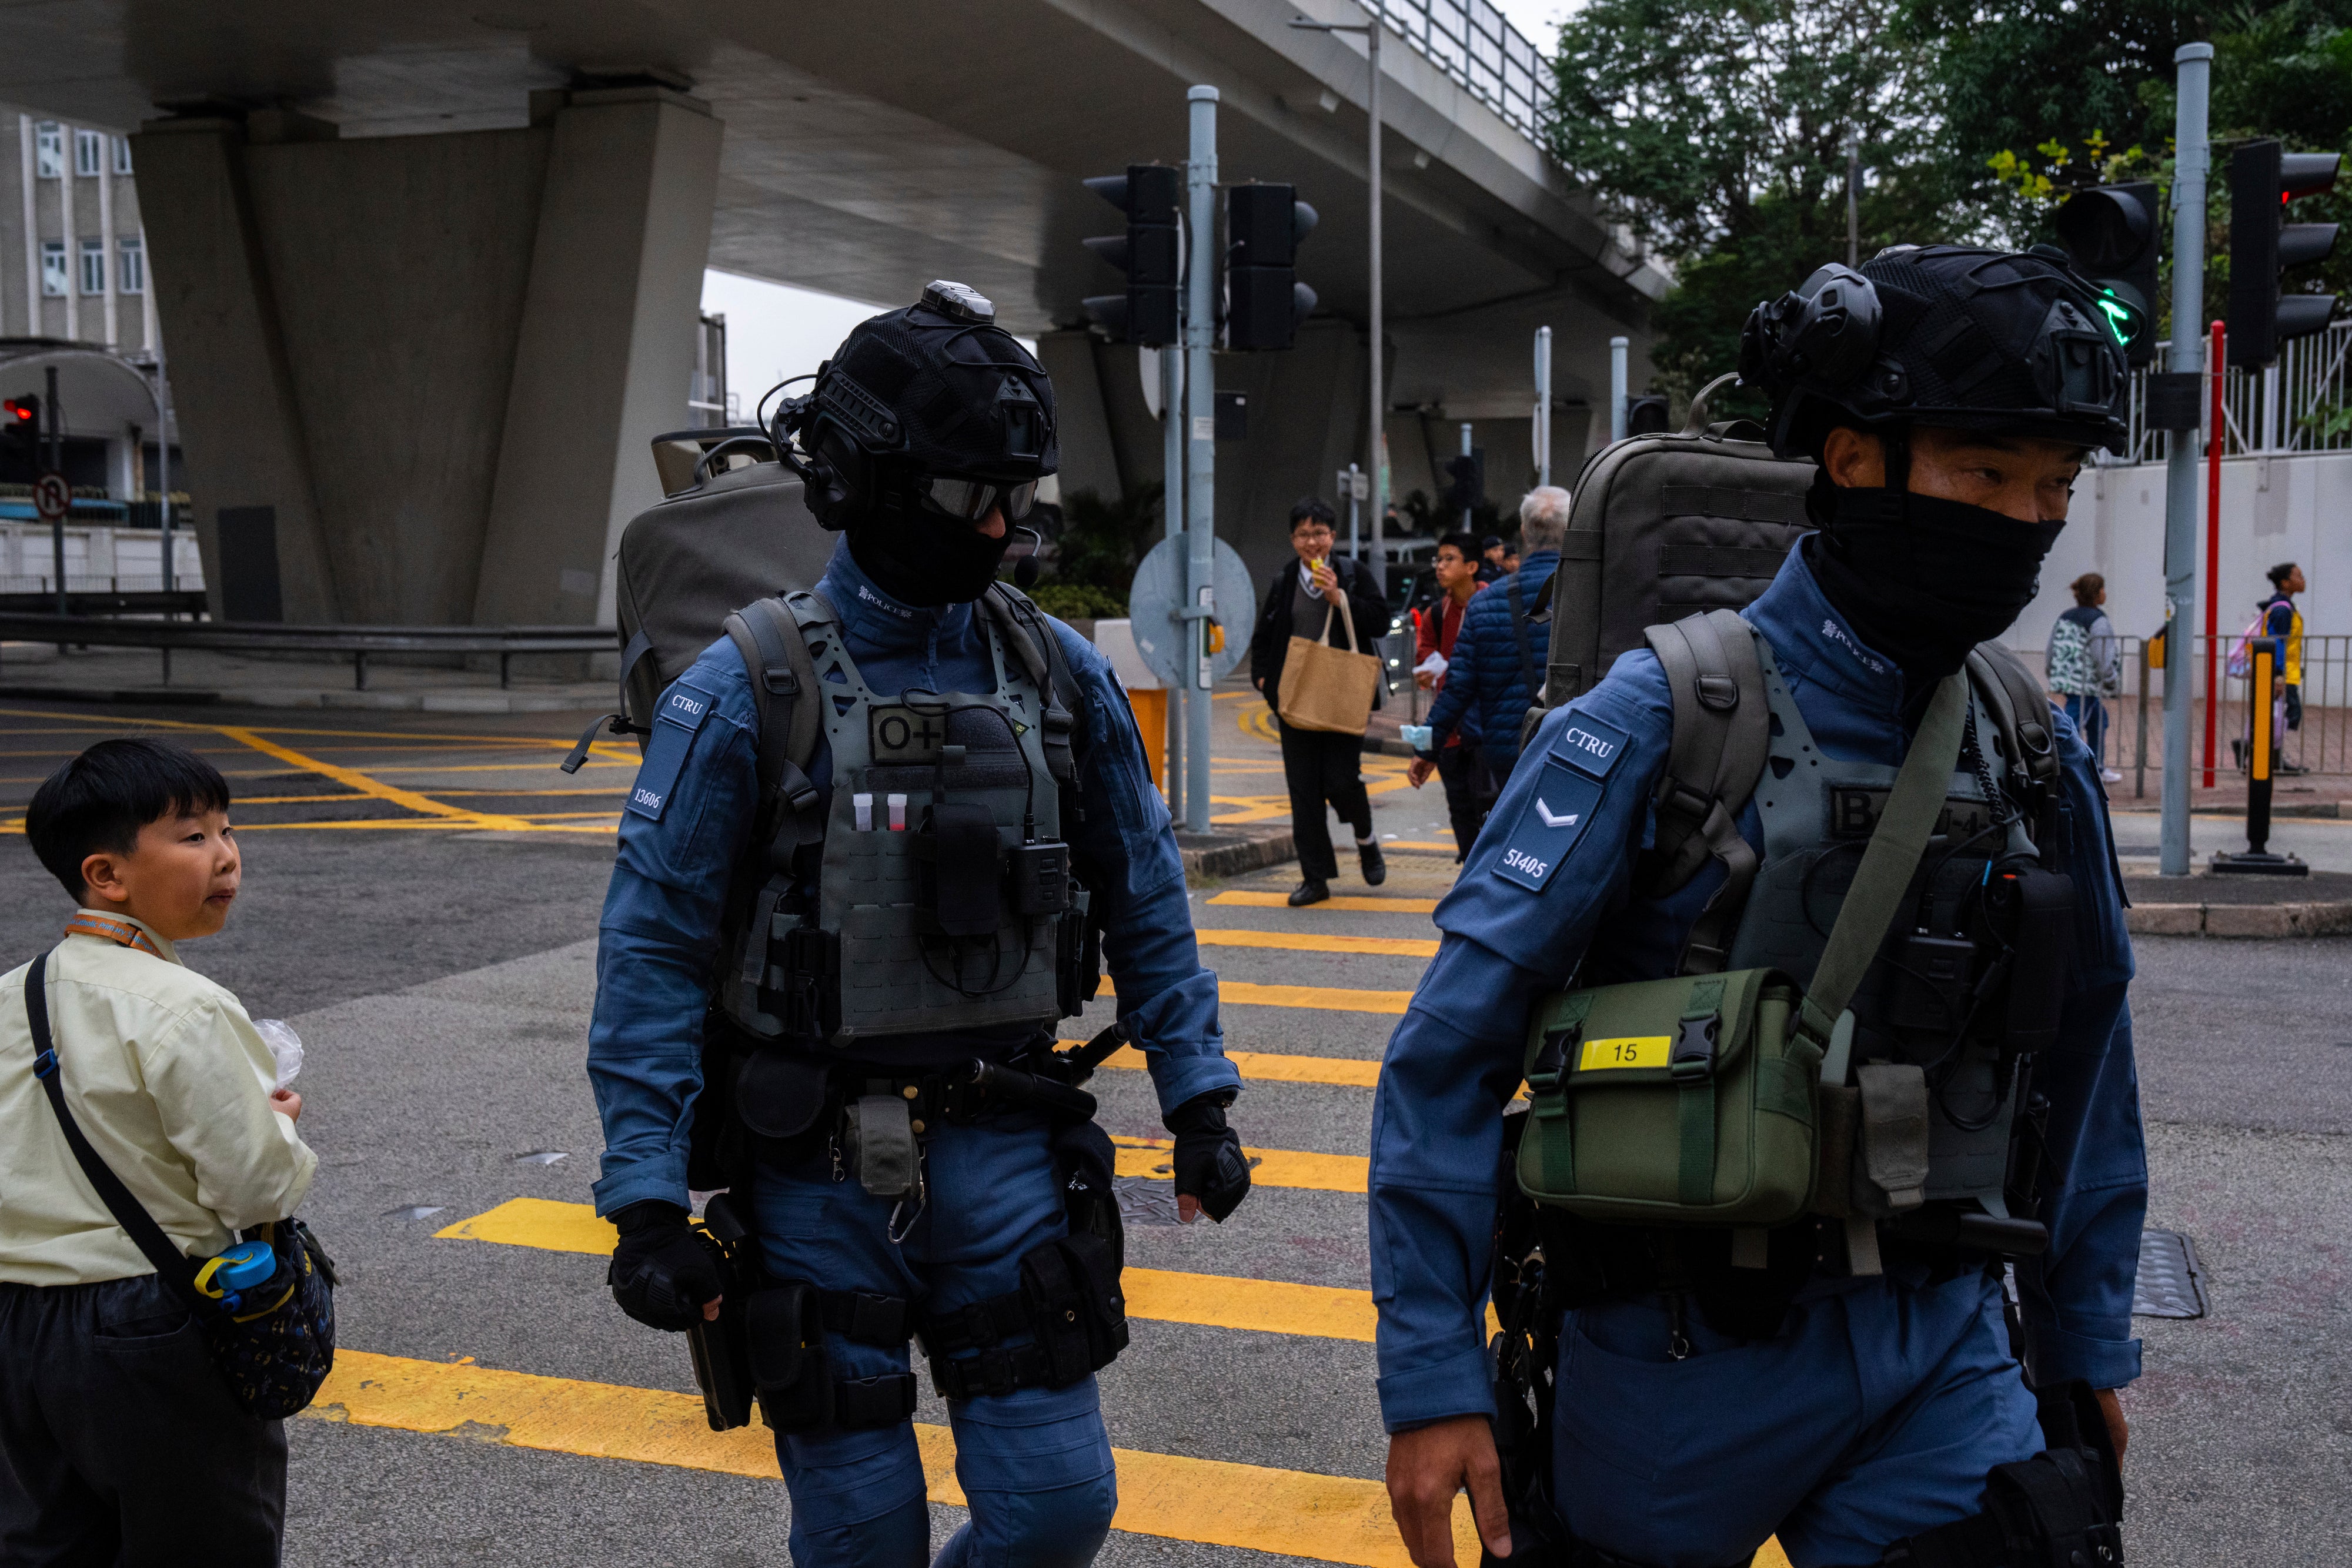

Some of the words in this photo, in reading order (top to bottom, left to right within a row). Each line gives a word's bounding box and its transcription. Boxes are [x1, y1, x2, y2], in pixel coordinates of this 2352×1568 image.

[672, 694, 703, 714] CTRU
[1566, 727, 1613, 758] CTRU
[634, 788, 662, 808] 13606
[1503, 848, 1548, 878] 51405
[99, 921, 126, 936] Primary
[1614, 1044, 1637, 1061] 15
